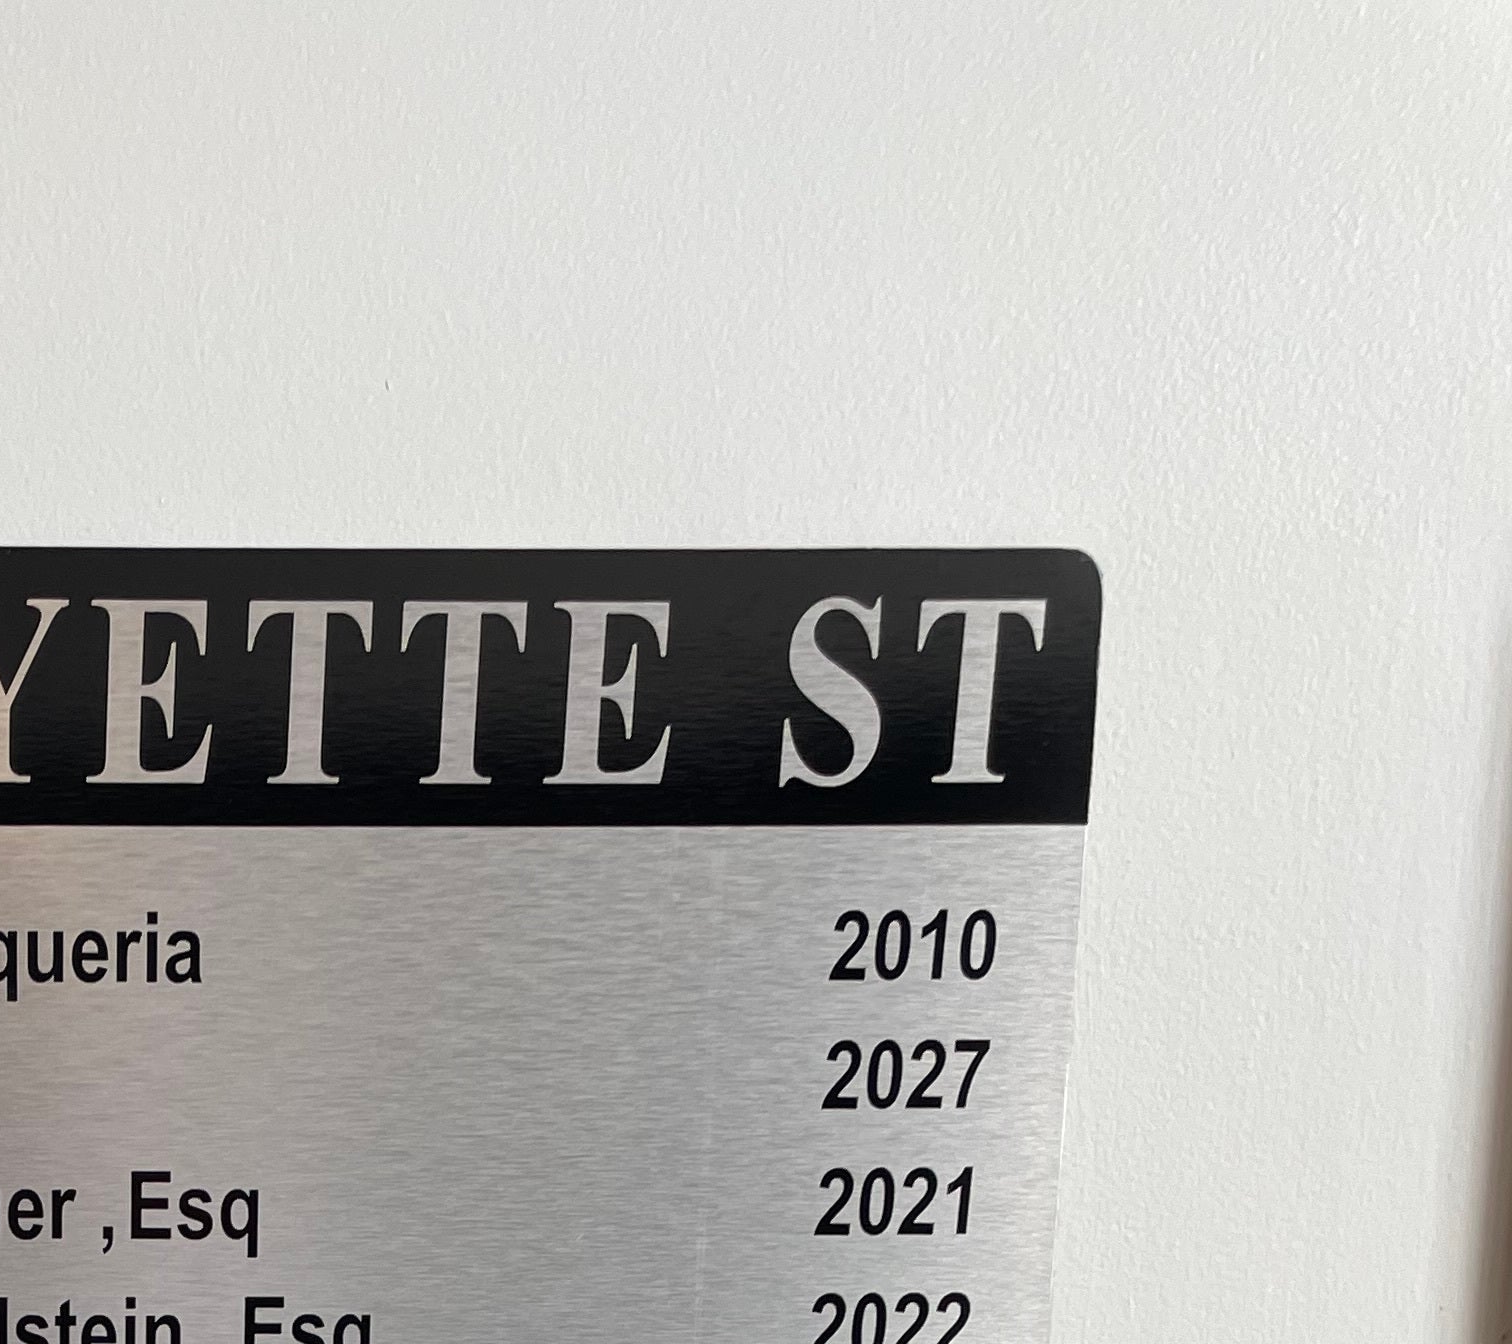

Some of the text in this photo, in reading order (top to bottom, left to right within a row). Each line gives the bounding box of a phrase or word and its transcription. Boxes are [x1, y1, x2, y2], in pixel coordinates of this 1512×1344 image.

[778, 595, 1049, 788] ST
[828, 908, 997, 981] 2010
[821, 1038, 991, 1110] 2027
[813, 1166, 974, 1237] 2021
